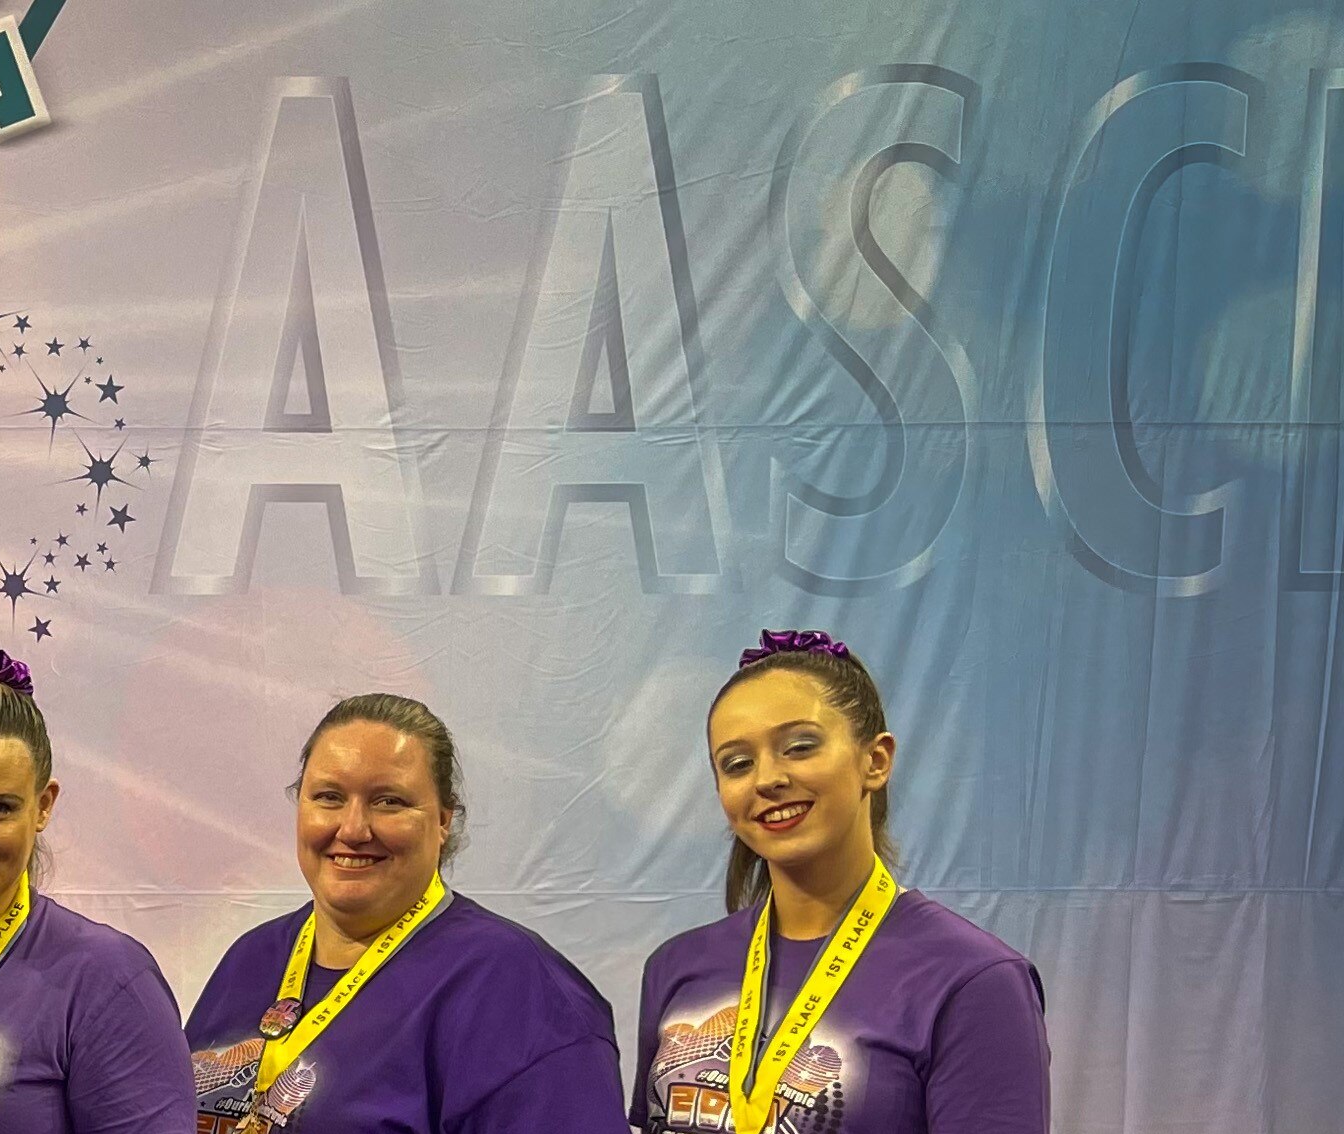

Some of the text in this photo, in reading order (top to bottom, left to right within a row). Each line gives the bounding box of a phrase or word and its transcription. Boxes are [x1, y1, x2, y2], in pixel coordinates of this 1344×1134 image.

[312, 896, 430, 1027] 1ST PLACE 1ST PLACE
[773, 873, 890, 1062] 1ST PLACE 1ST PLACE 1ST
[736, 1018, 748, 1058] PLACE
